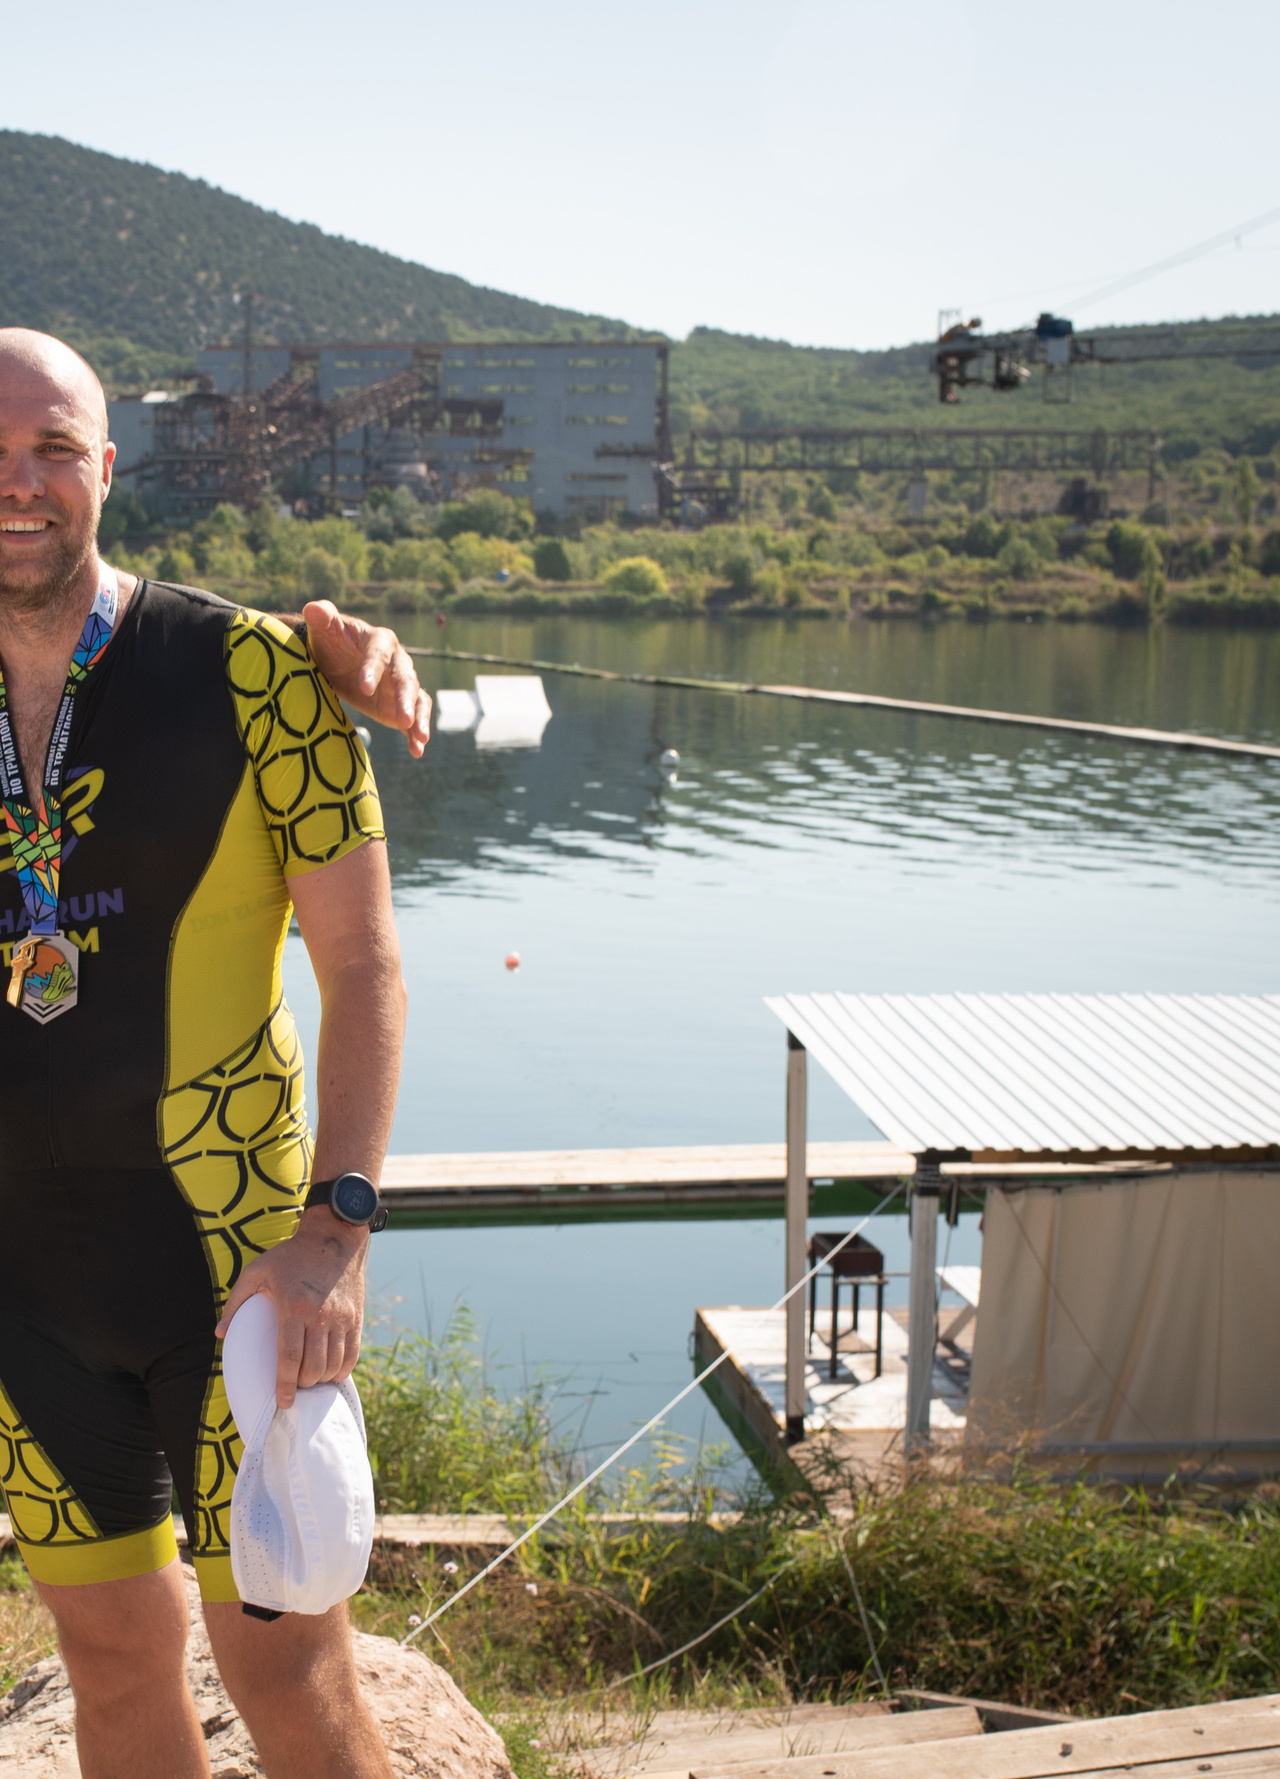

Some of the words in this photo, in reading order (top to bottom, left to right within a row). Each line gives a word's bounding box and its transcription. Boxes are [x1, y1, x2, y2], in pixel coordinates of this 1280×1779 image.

[44, 744, 57, 787] ЧЕМПИОНАТ
[51, 695, 71, 744] СЕВАСТОПОЛЯ
[9, 777, 24, 796] ПО
[50, 768, 60, 786] ПО
